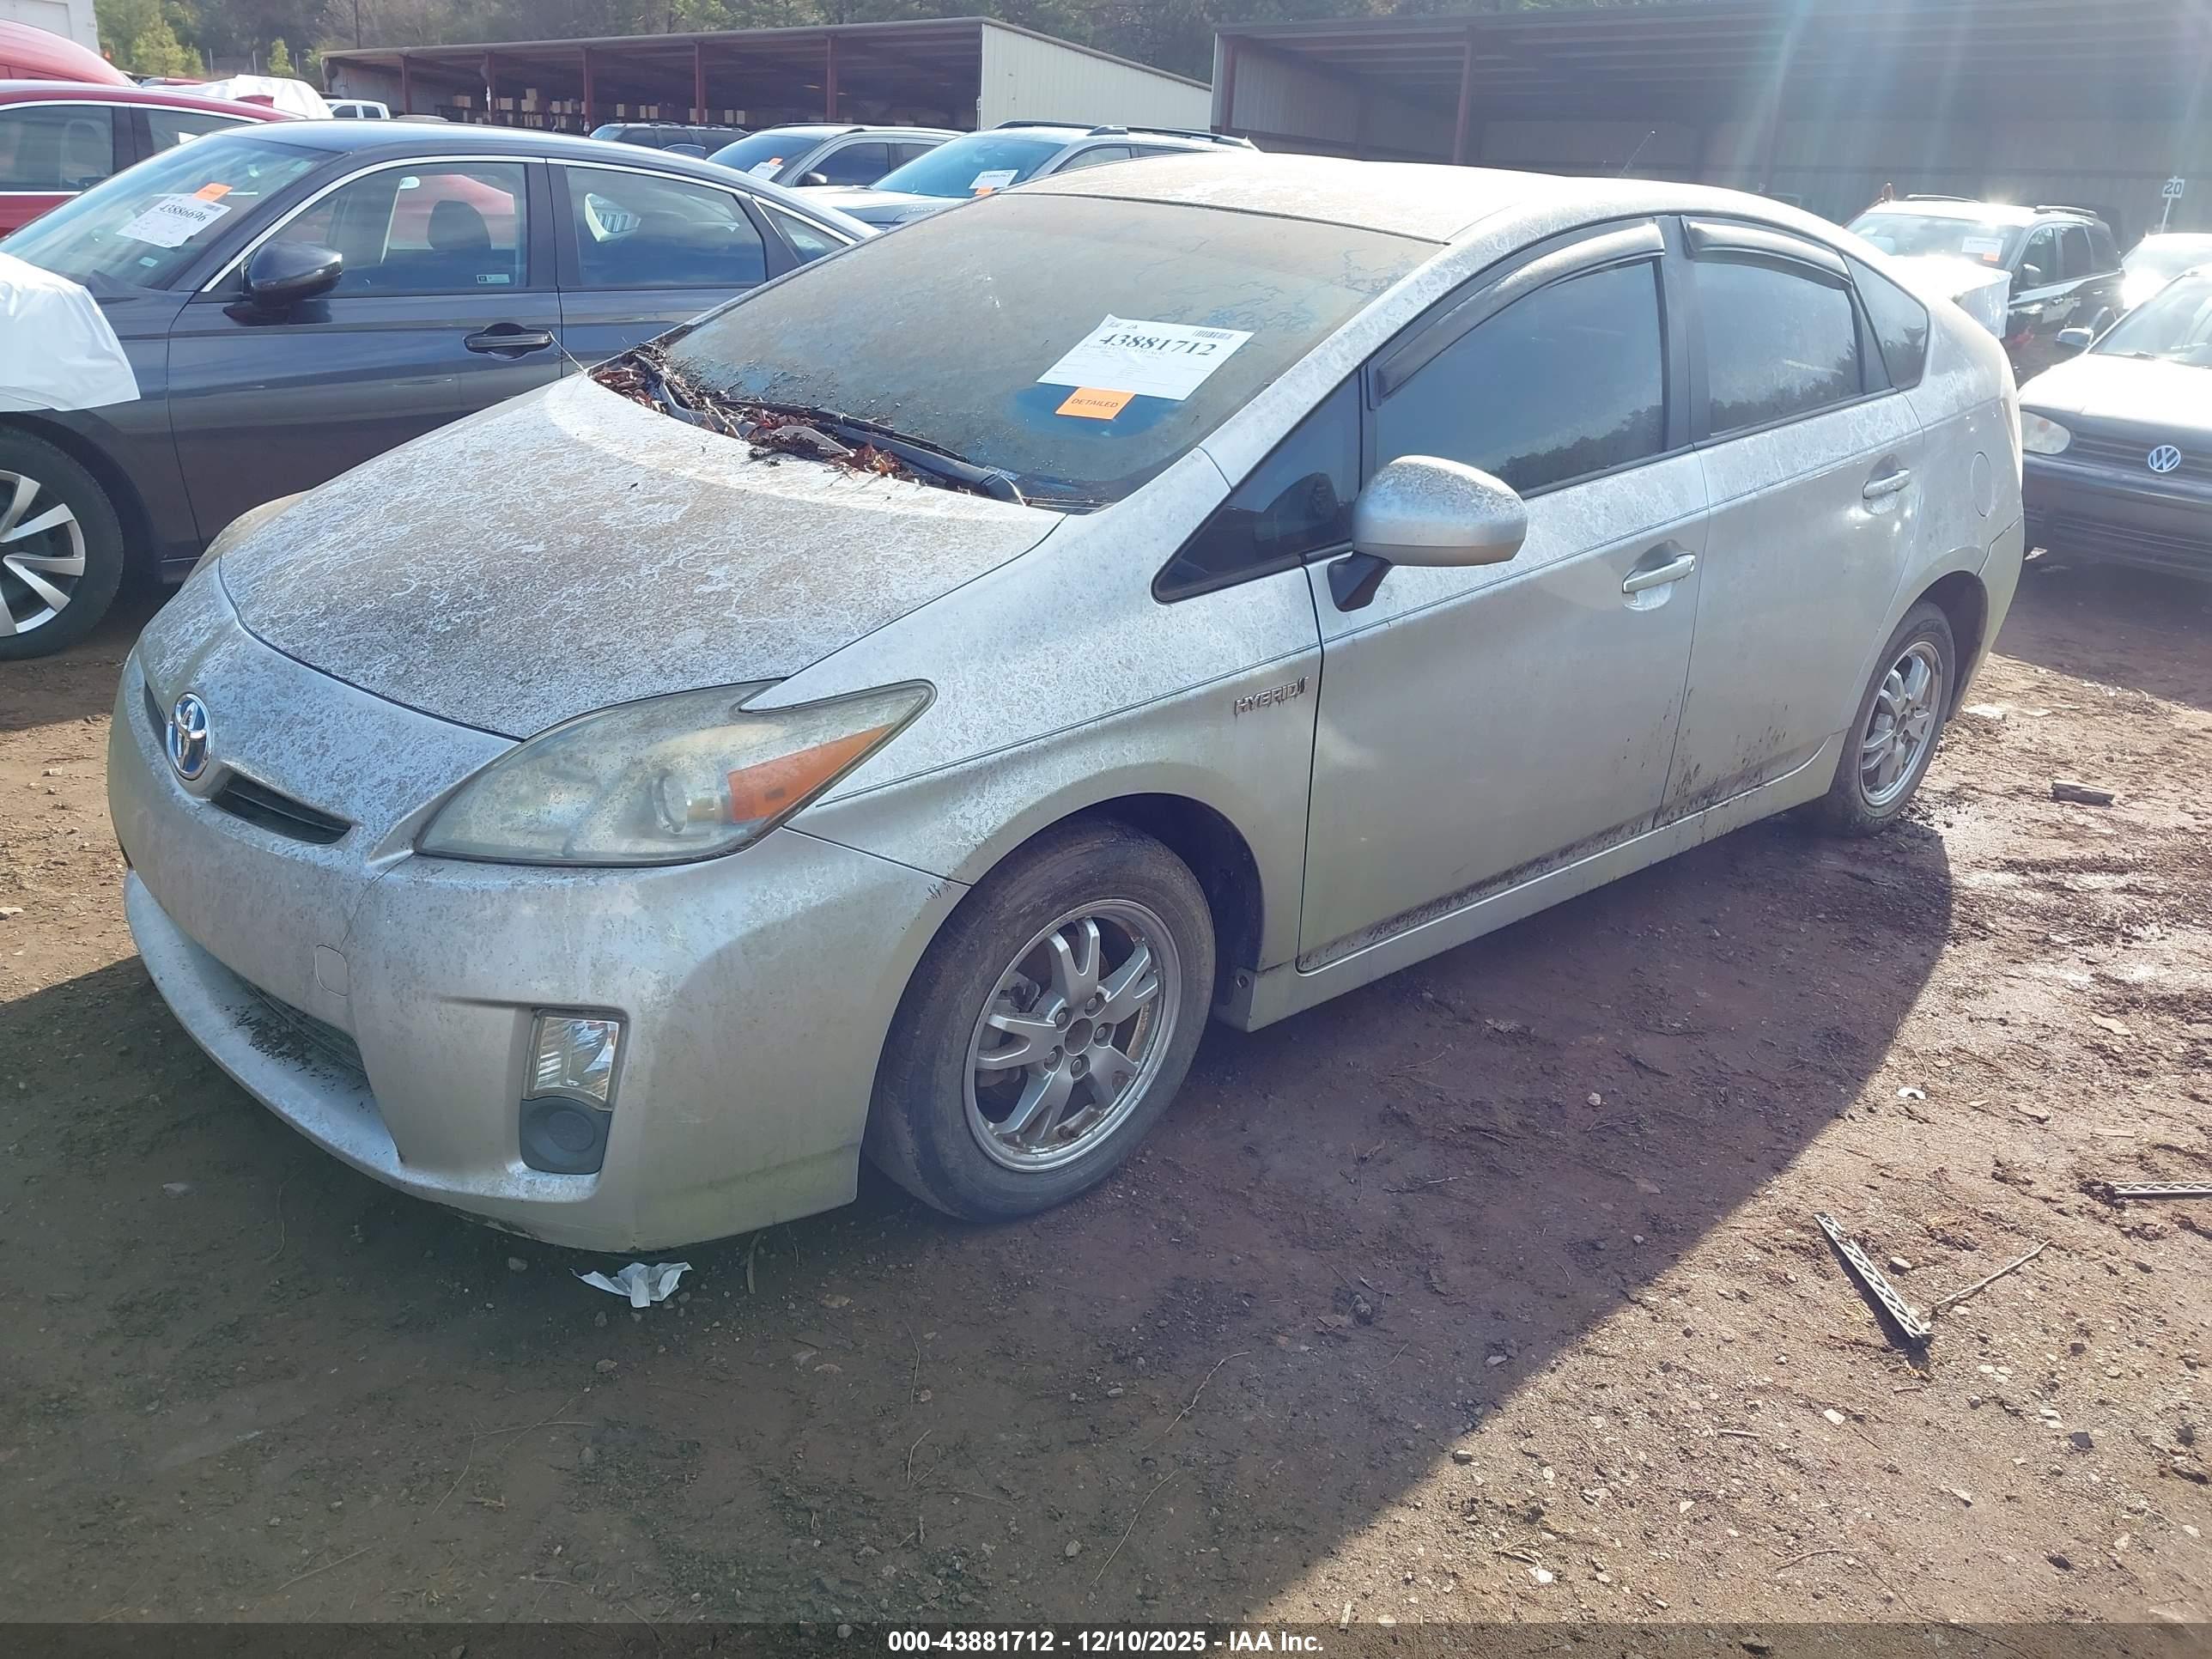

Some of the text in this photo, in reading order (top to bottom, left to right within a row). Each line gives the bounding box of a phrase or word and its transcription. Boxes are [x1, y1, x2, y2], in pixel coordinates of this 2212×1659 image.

[2164, 181, 2182, 195] 20
[1099, 333, 1218, 356] 43881712
[1071, 398, 1119, 409] DETAILED
[1234, 681, 1299, 716] HYBRID
